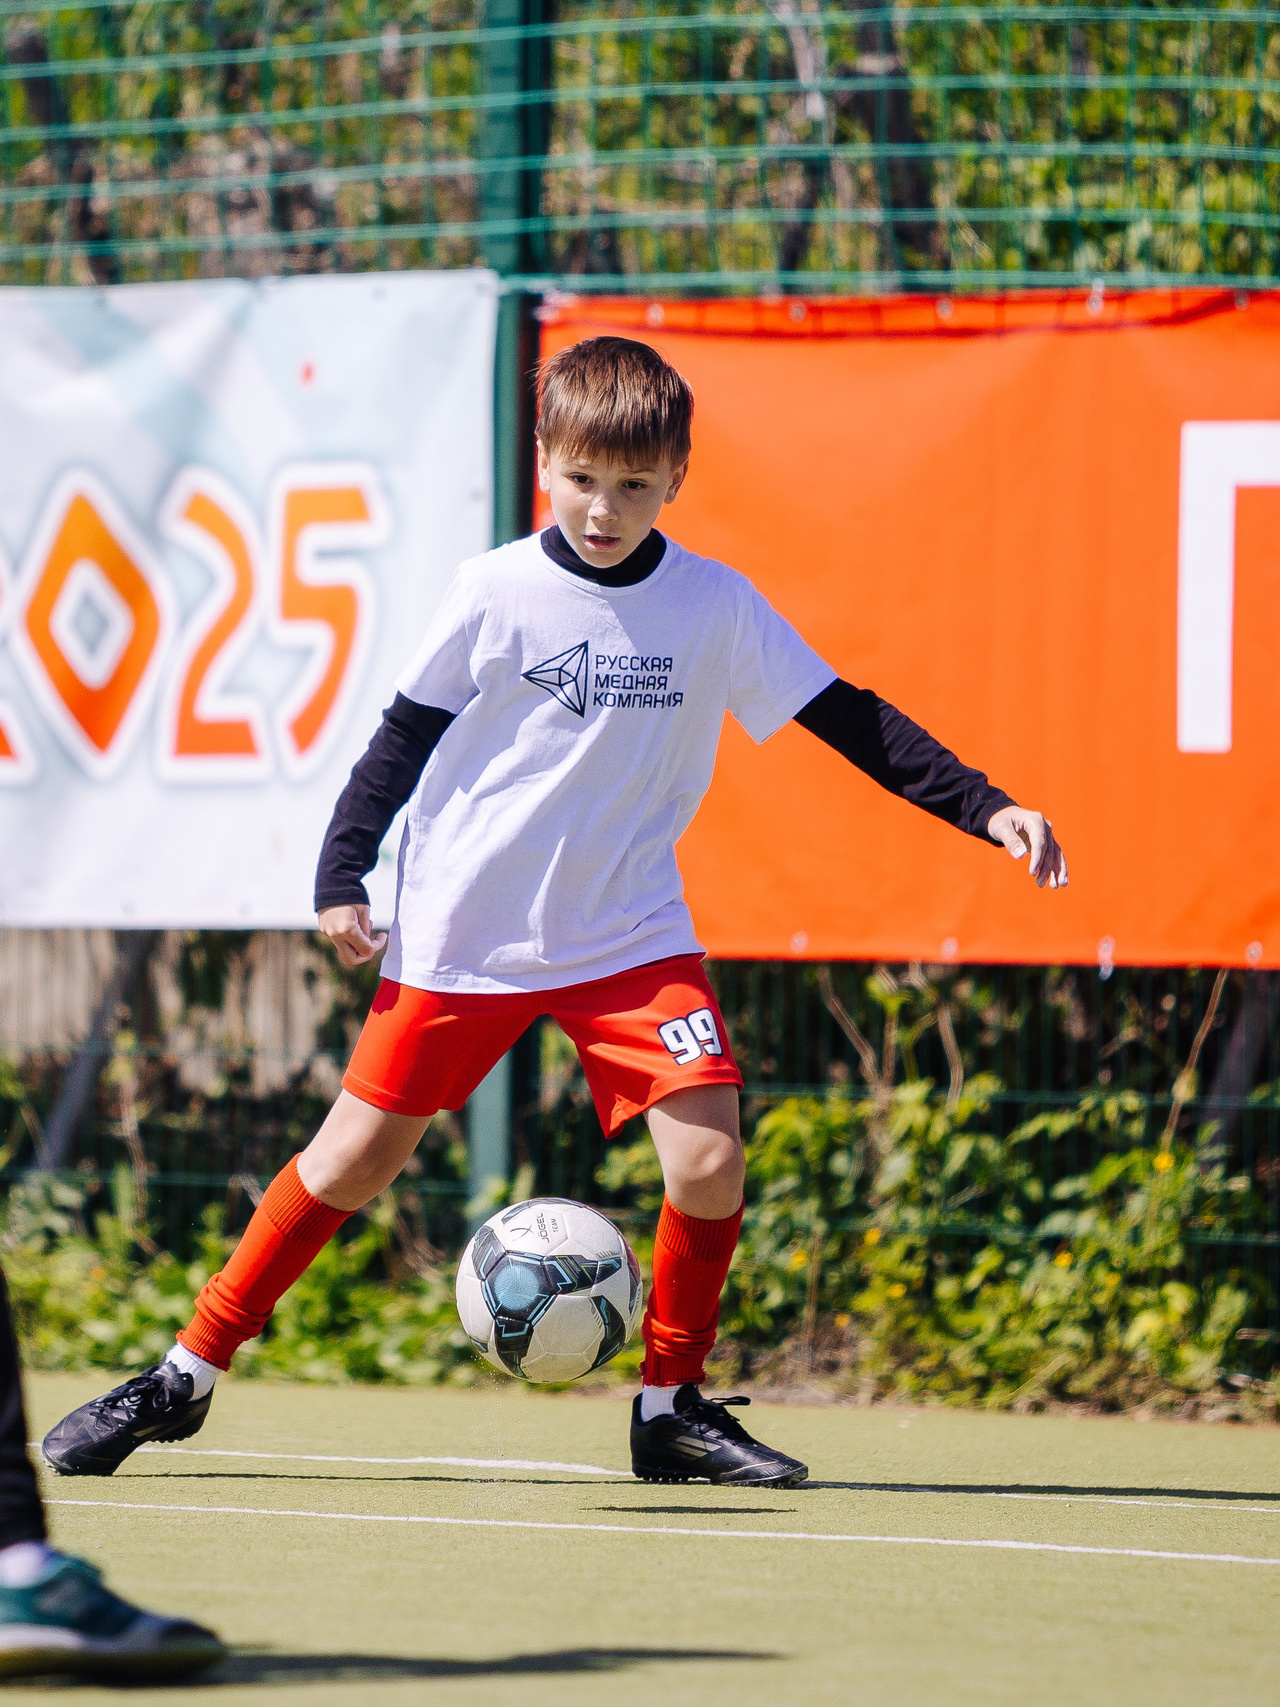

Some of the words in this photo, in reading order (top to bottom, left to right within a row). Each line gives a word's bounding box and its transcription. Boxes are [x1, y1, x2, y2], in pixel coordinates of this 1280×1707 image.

[595, 654, 673, 672] РУССКАЯ
[594, 674, 668, 690] МЕДНАЯ
[657, 1007, 723, 1066] 99
